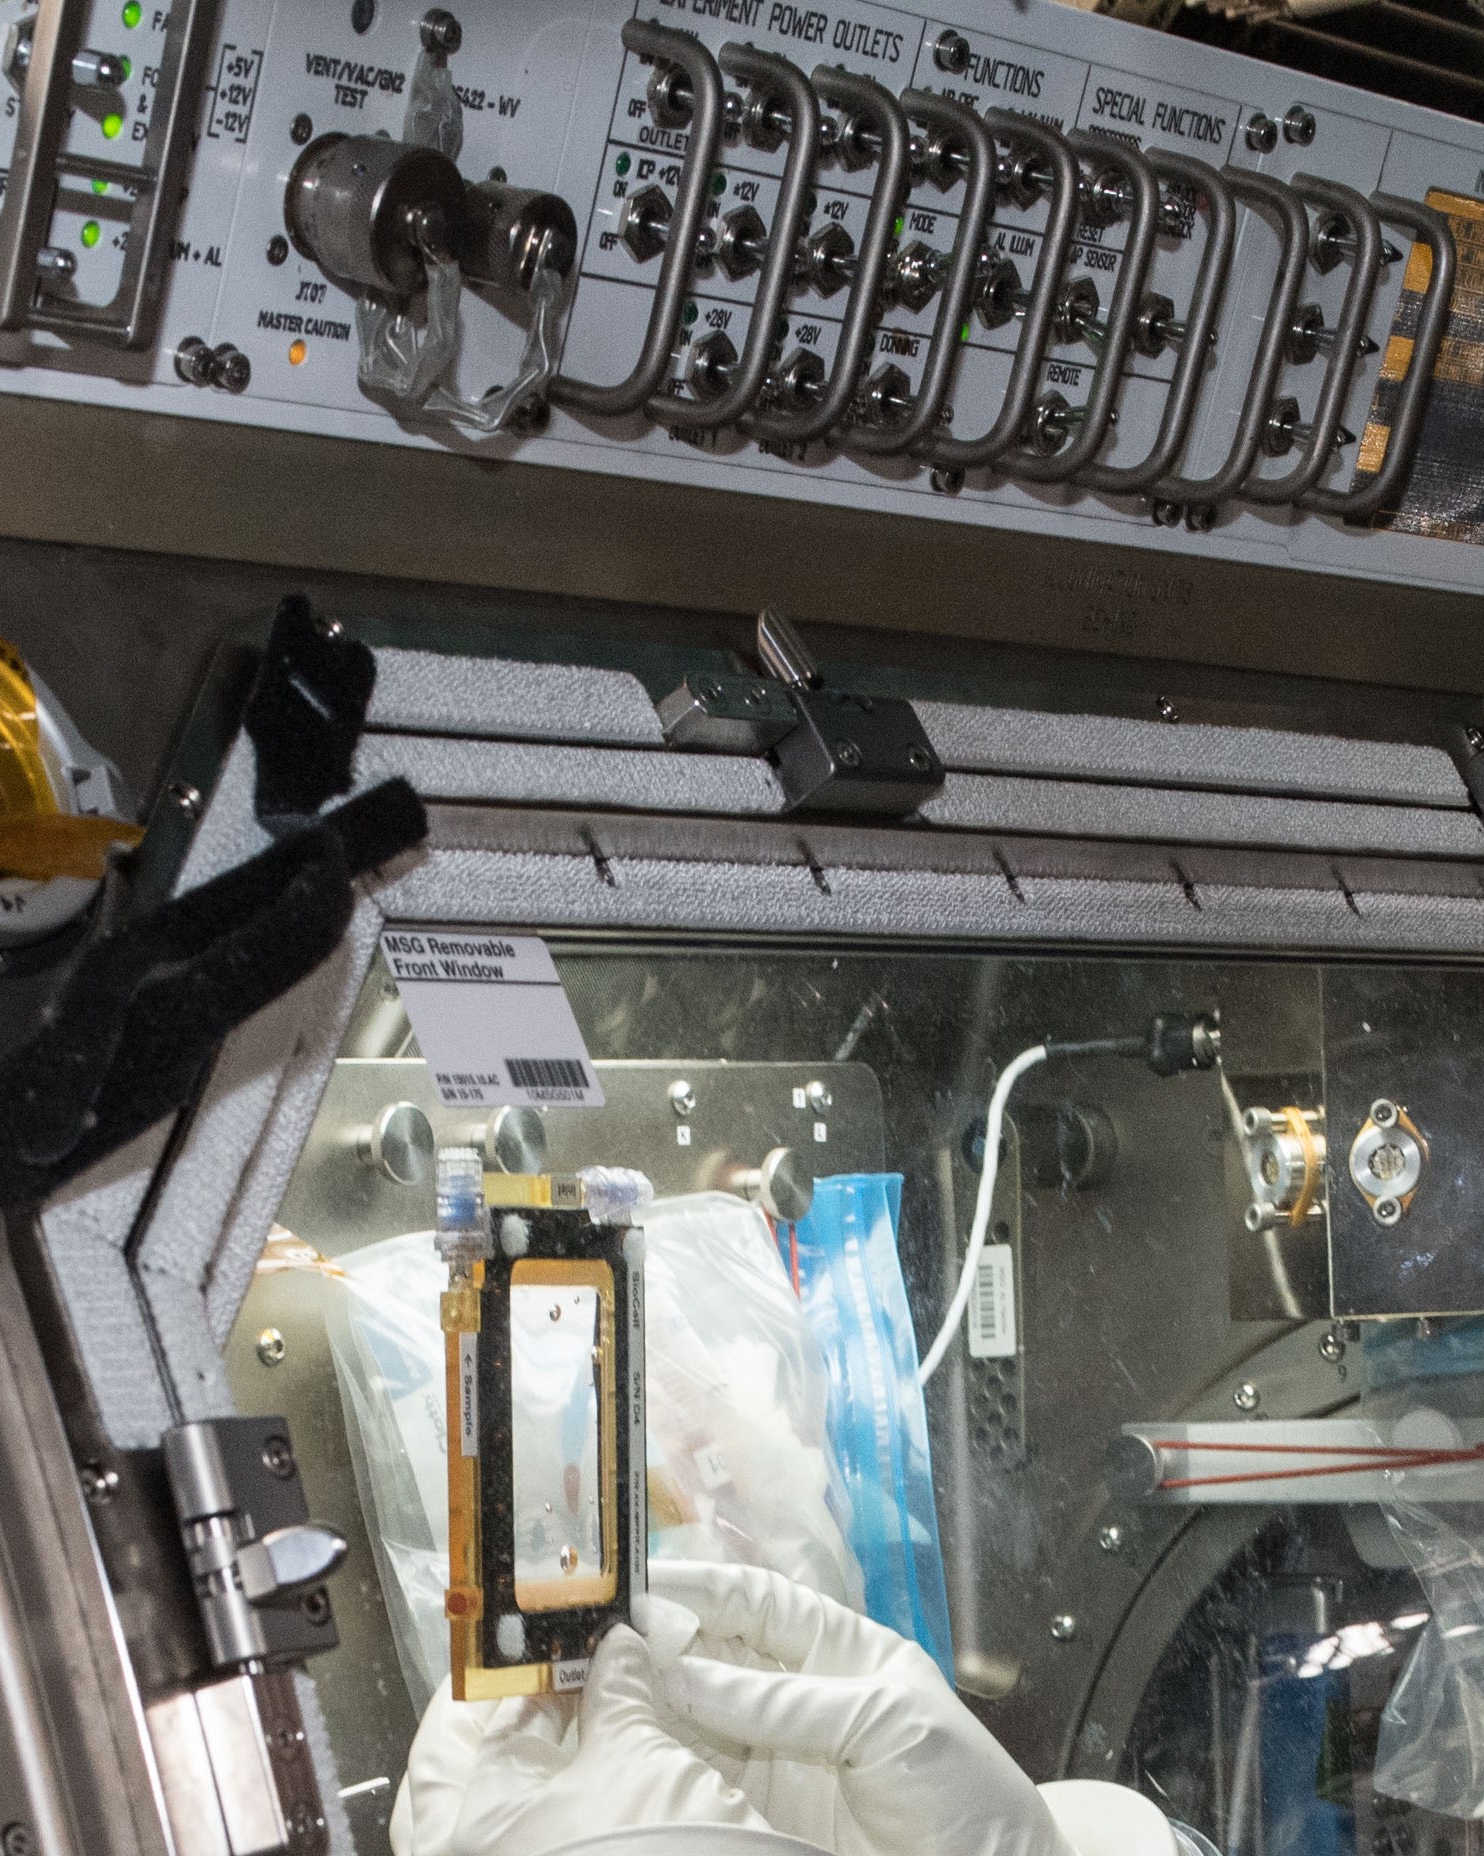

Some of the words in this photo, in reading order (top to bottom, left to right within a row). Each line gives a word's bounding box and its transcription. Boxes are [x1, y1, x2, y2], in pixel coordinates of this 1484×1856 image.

[769, 3, 826, 44] POWER
[833, 20, 904, 63] OUTLETS
[226, 56, 255, 79] +5V
[305, 53, 406, 94] VENT/VAC/GN2
[964, 53, 1045, 98] FUNCTIONS
[219, 83, 253, 107] +12V
[334, 83, 368, 110] TEST
[627, 98, 647, 119] OFF
[1092, 86, 1145, 126] SPECIAL
[1151, 101, 1226, 145] FUNCTIONS
[215, 115, 250, 135] -12V
[909, 212, 938, 235] MODE
[599, 231, 619, 251] OFF
[1009, 233, 1036, 257] ILLUM
[1084, 248, 1117, 272] SENSOR
[256, 310, 303, 334] MASTER
[303, 316, 351, 341] CAUTION
[704, 310, 732, 331] +28V
[794, 324, 822, 347] +28V
[1046, 364, 1082, 388] REMOTE
[384, 935, 426, 954] MSG
[426, 936, 516, 958] Removable
[393, 957, 439, 979] Front
[439, 960, 504, 979] Window
[464, 1374, 473, 1437] Sample
[558, 1668, 587, 1684] Outlet
